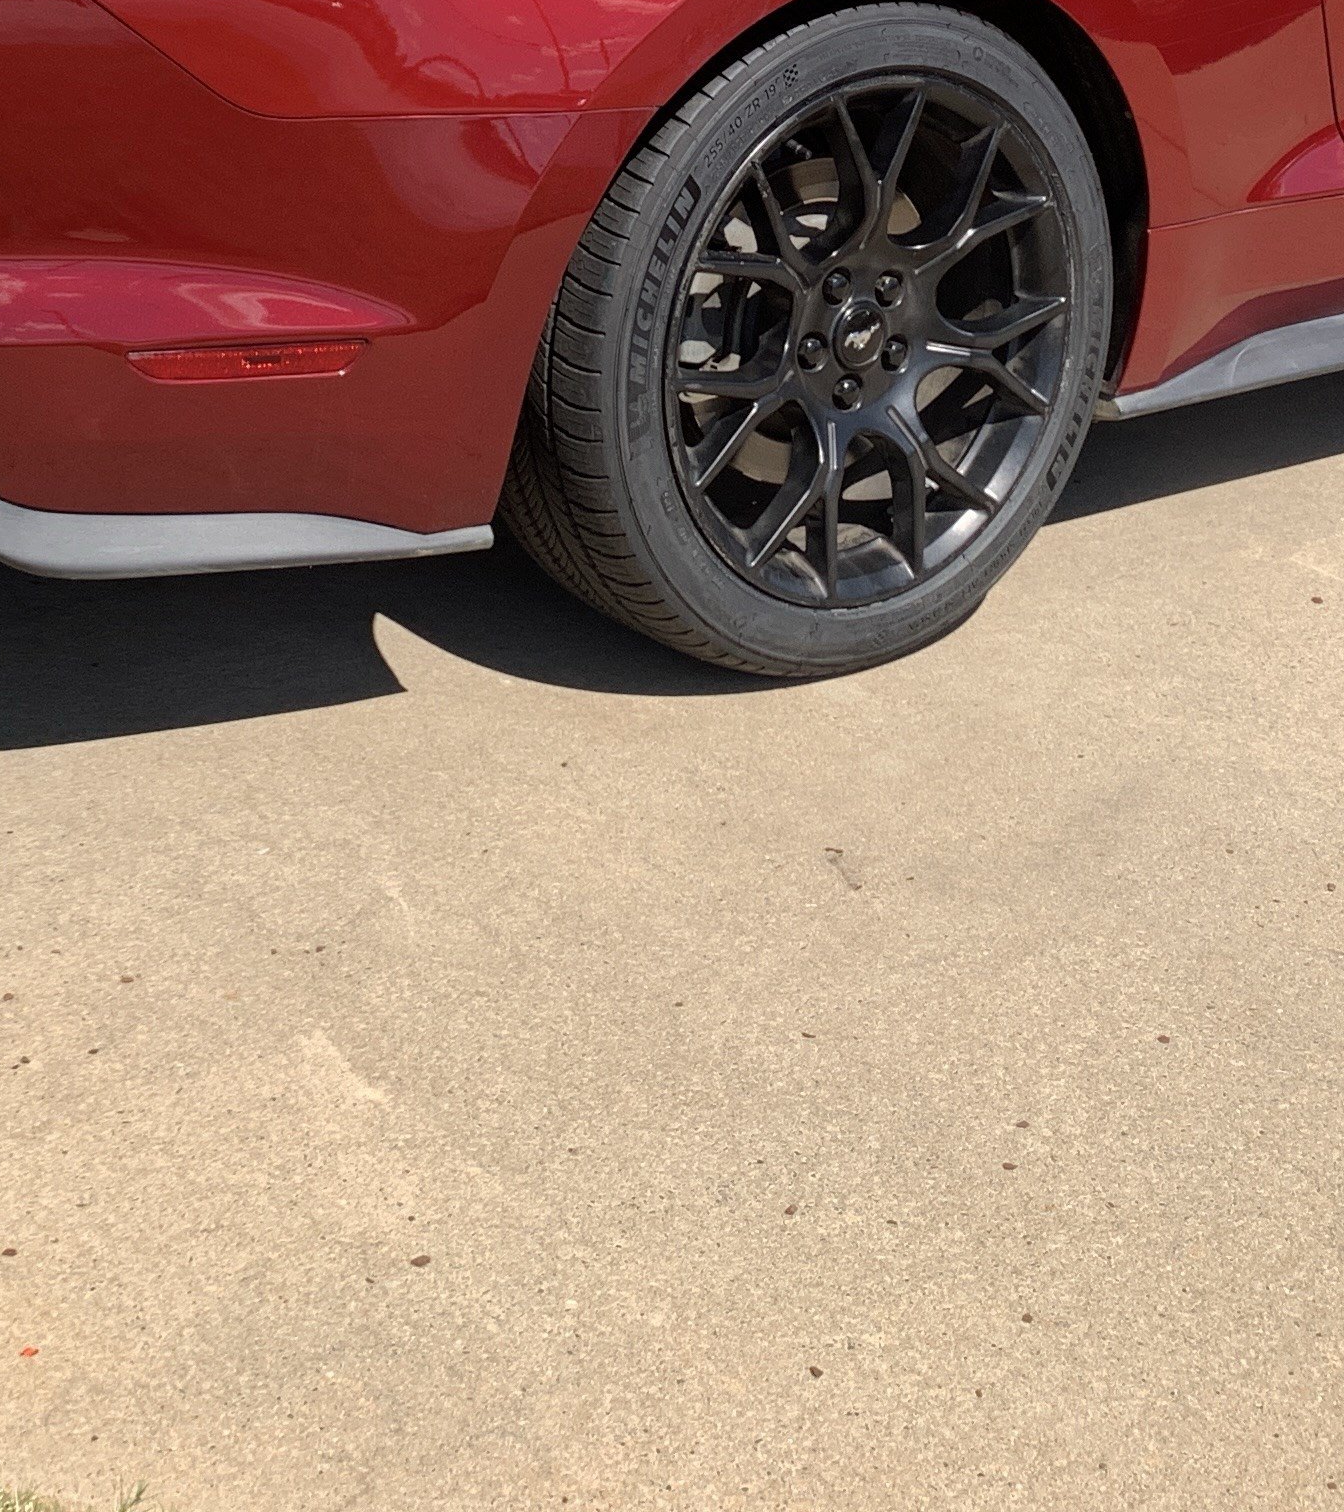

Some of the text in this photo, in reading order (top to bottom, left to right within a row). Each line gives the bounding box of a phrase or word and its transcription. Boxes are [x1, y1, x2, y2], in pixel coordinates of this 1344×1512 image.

[703, 115, 743, 169] 255/40
[744, 97, 761, 119] ZR
[628, 180, 698, 387] MICHELIN
